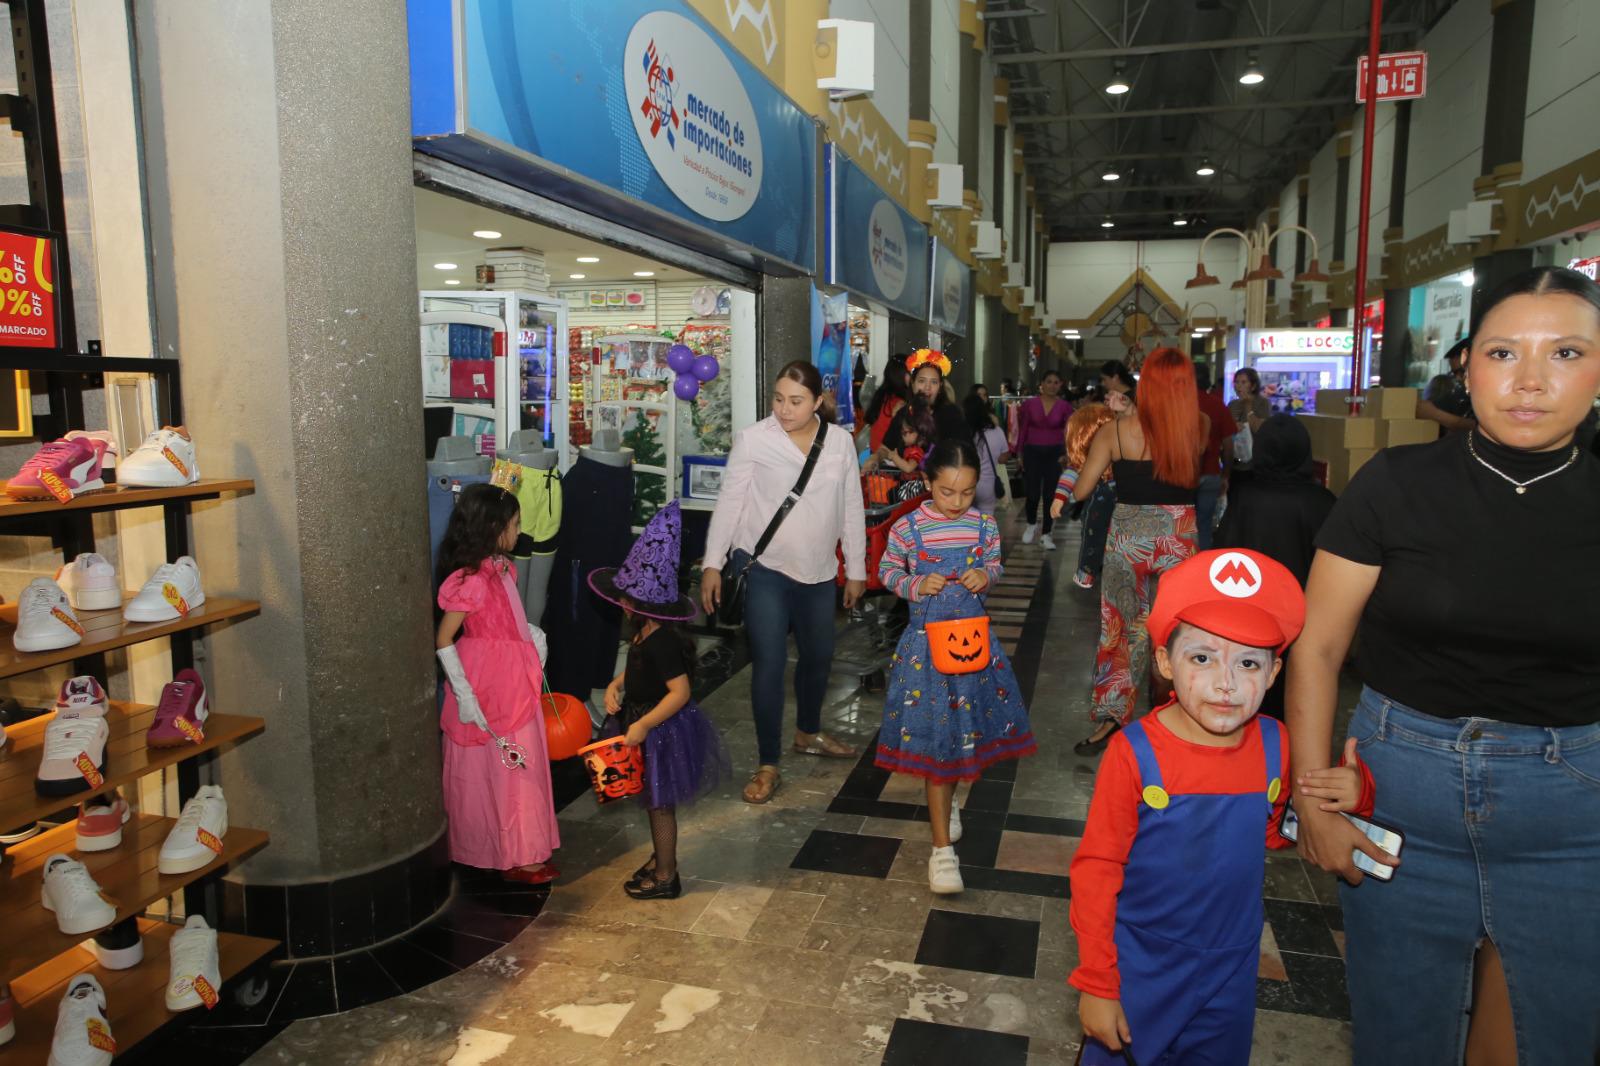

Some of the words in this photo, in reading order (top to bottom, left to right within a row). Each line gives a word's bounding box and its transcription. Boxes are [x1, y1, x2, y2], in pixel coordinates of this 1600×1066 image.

[688, 93, 730, 137] mercado
[733, 121, 744, 147] de
[684, 108, 752, 177] importaciones
[13, 253, 27, 284] OFF
[31, 291, 43, 317] OFF
[0, 325, 47, 336] MARCADO
[41, 470, 66, 494] 40%
[1215, 560, 1256, 588] M
[73, 696, 88, 704] NIKE
